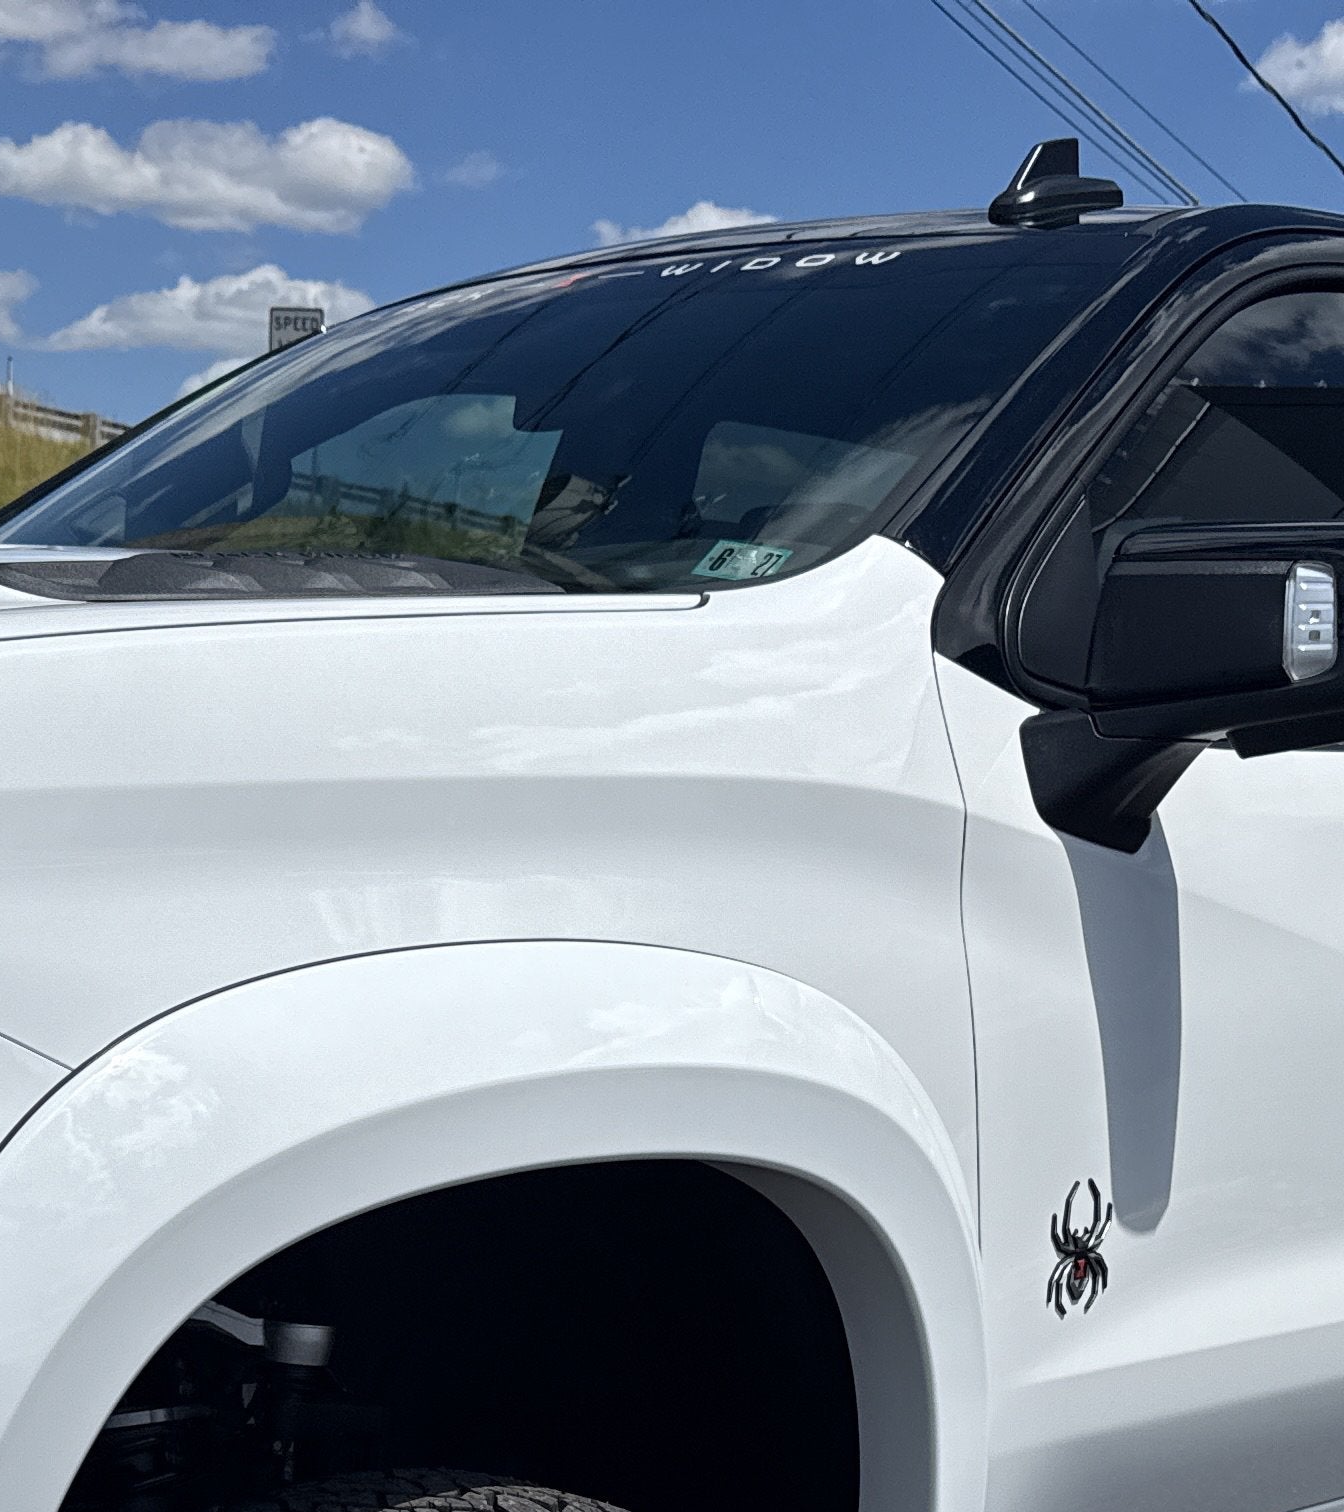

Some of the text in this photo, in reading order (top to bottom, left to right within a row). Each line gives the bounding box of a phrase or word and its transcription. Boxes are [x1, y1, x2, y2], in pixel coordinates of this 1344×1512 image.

[660, 250, 903, 278] WIDOW
[709, 548, 783, 577] 6 27
